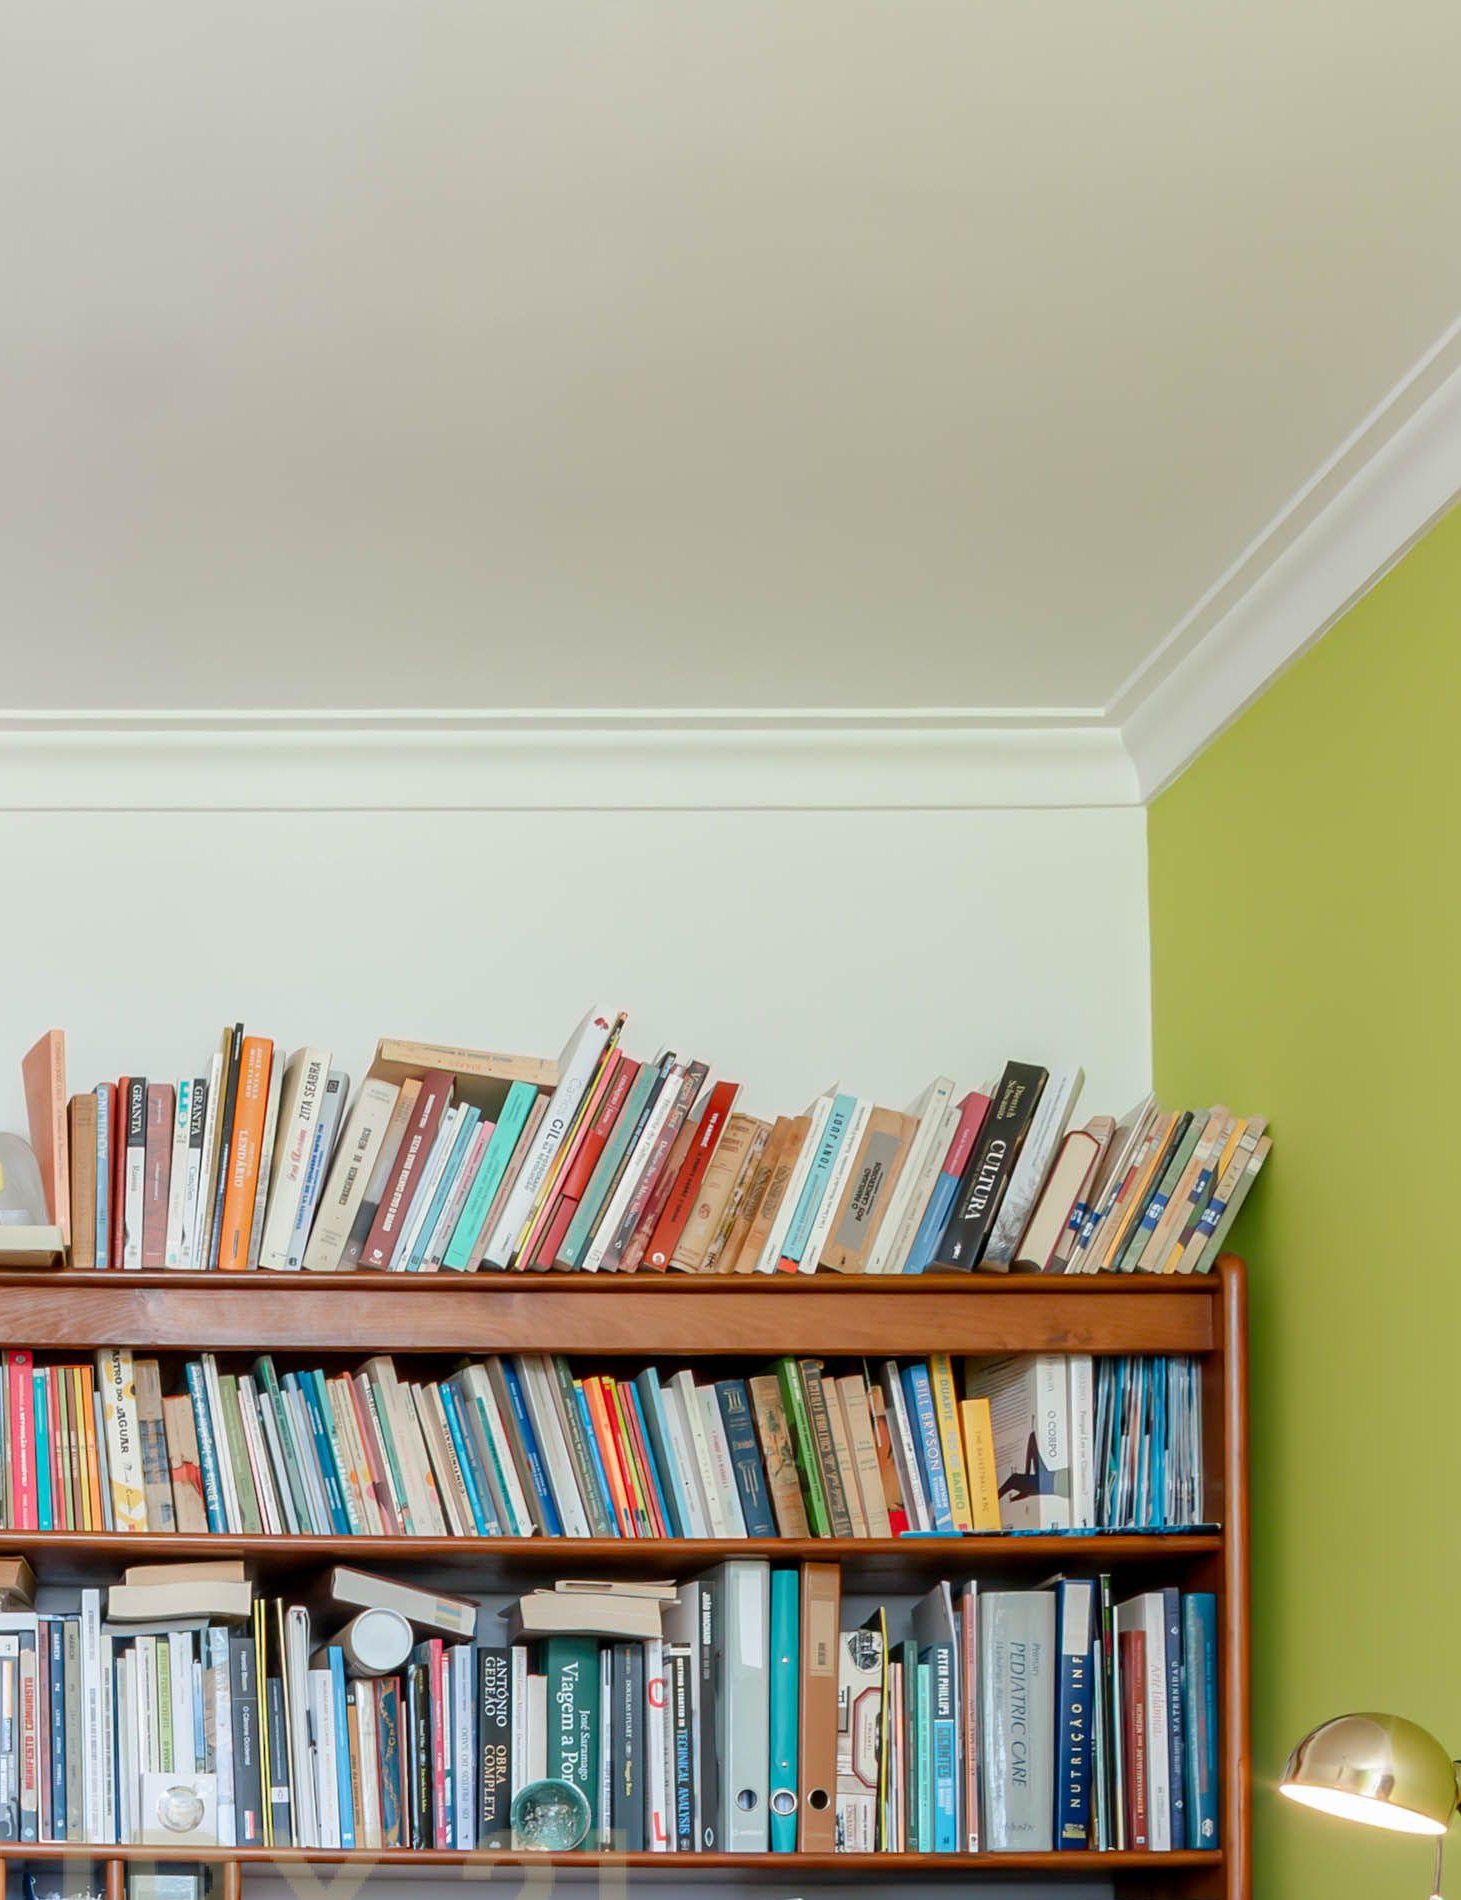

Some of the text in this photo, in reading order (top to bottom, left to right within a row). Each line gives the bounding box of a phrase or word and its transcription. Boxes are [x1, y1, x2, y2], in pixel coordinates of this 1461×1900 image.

[130, 1084, 142, 1135] GRANTA
[190, 1086, 205, 1136] GRANTA
[298, 1061, 322, 1121] ZITA SEABRA
[1009, 1085, 1027, 1120] Dietrich
[817, 1112, 845, 1170] TONY JUDT
[965, 1139, 1007, 1221] CULTURA
[916, 1378, 943, 1472] BILL BRYSON
[1047, 1423, 1057, 1459] CORPO
[484, 1656, 496, 1717] GEDEÃO
[495, 1656, 507, 1728] ANTÓNIO
[937, 1648, 950, 1716] PETER PHILLIPS
[1010, 1641, 1027, 1788] PEDIATRIC CARE
[495, 1744, 507, 1784] OBRA
[578, 1709, 591, 1782] José Saramago
[483, 1744, 495, 1823] COMPLETA
